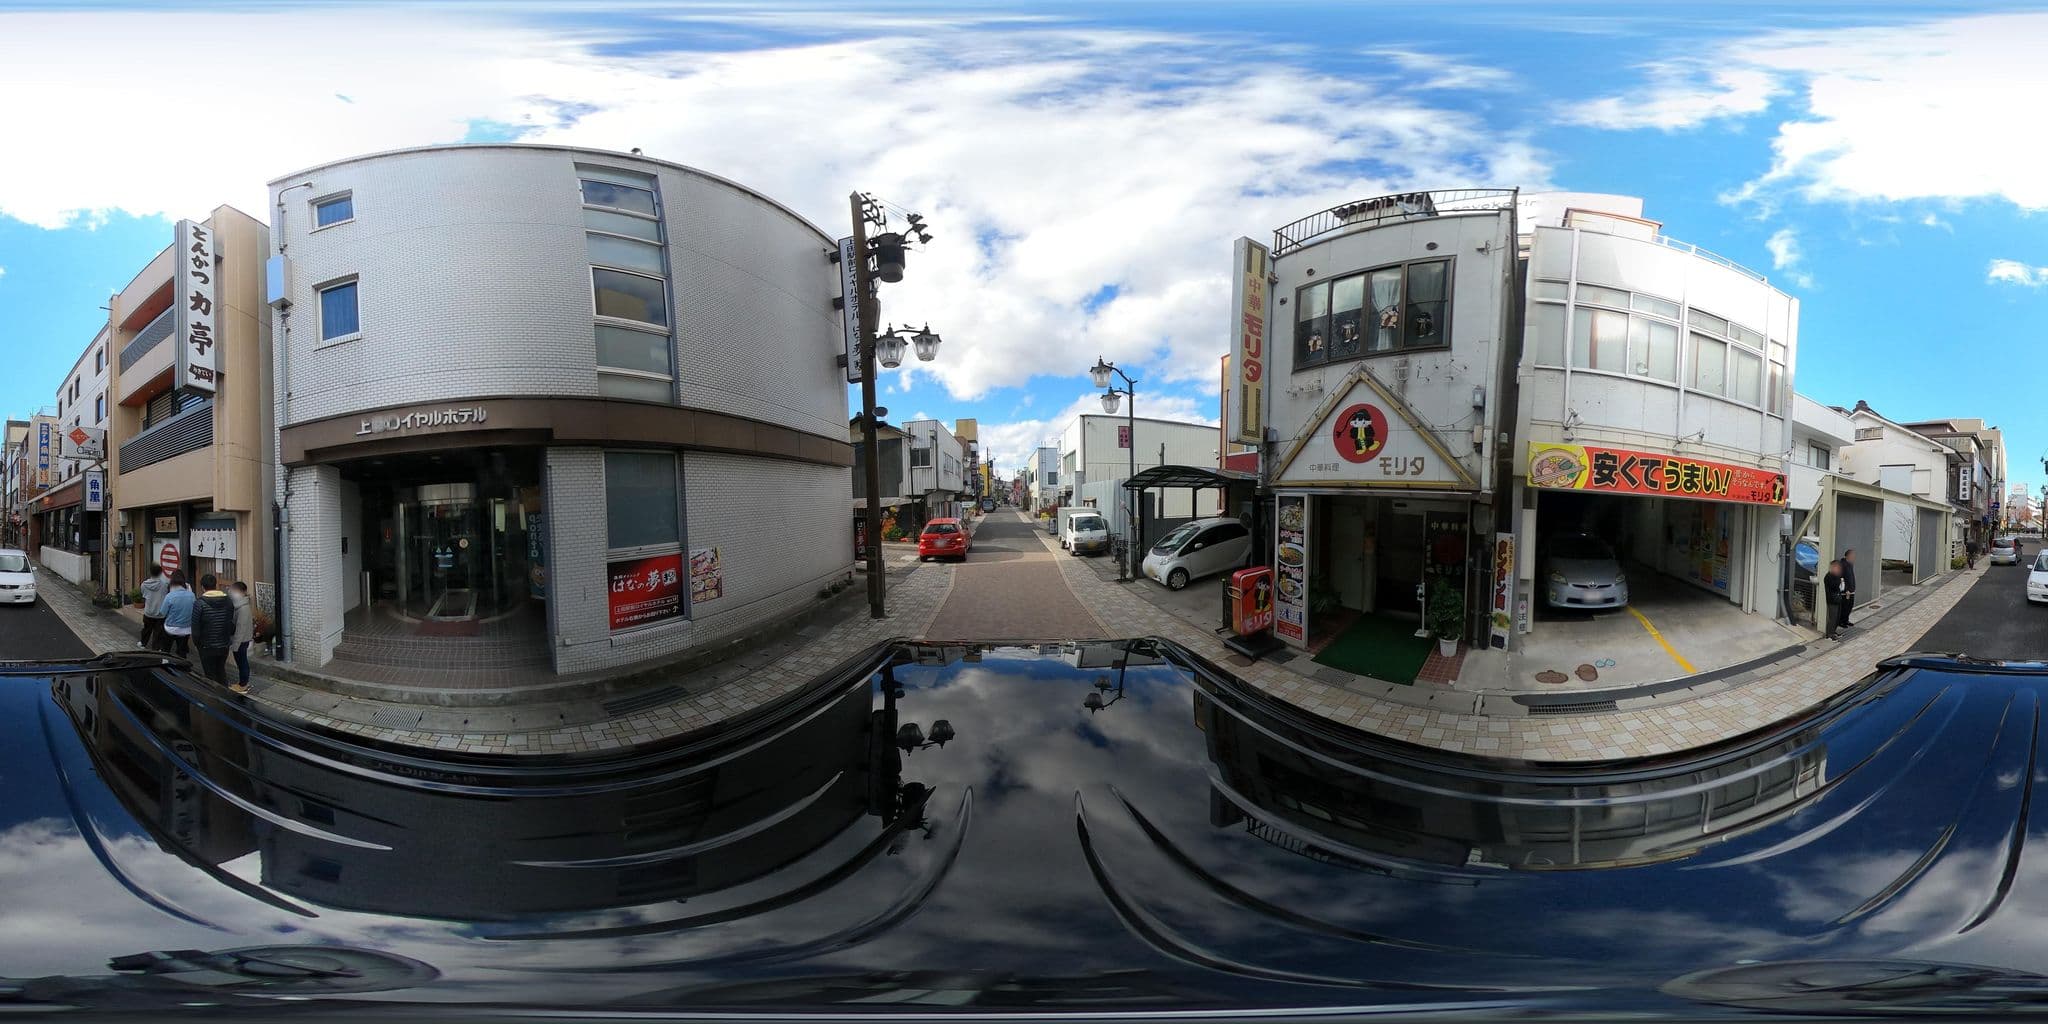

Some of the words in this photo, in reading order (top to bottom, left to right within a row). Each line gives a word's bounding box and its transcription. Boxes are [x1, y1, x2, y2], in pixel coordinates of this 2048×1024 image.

[191, 226, 210, 285] とんかつ
[189, 291, 213, 356] 力亭
[1243, 312, 1263, 383] モリタ
[356, 406, 487, 435] 上ロイヤルホテル
[1309, 463, 1340, 472] 中華料理
[1379, 457, 1425, 476] モリタ
[1750, 490, 1771, 502] モリタ
